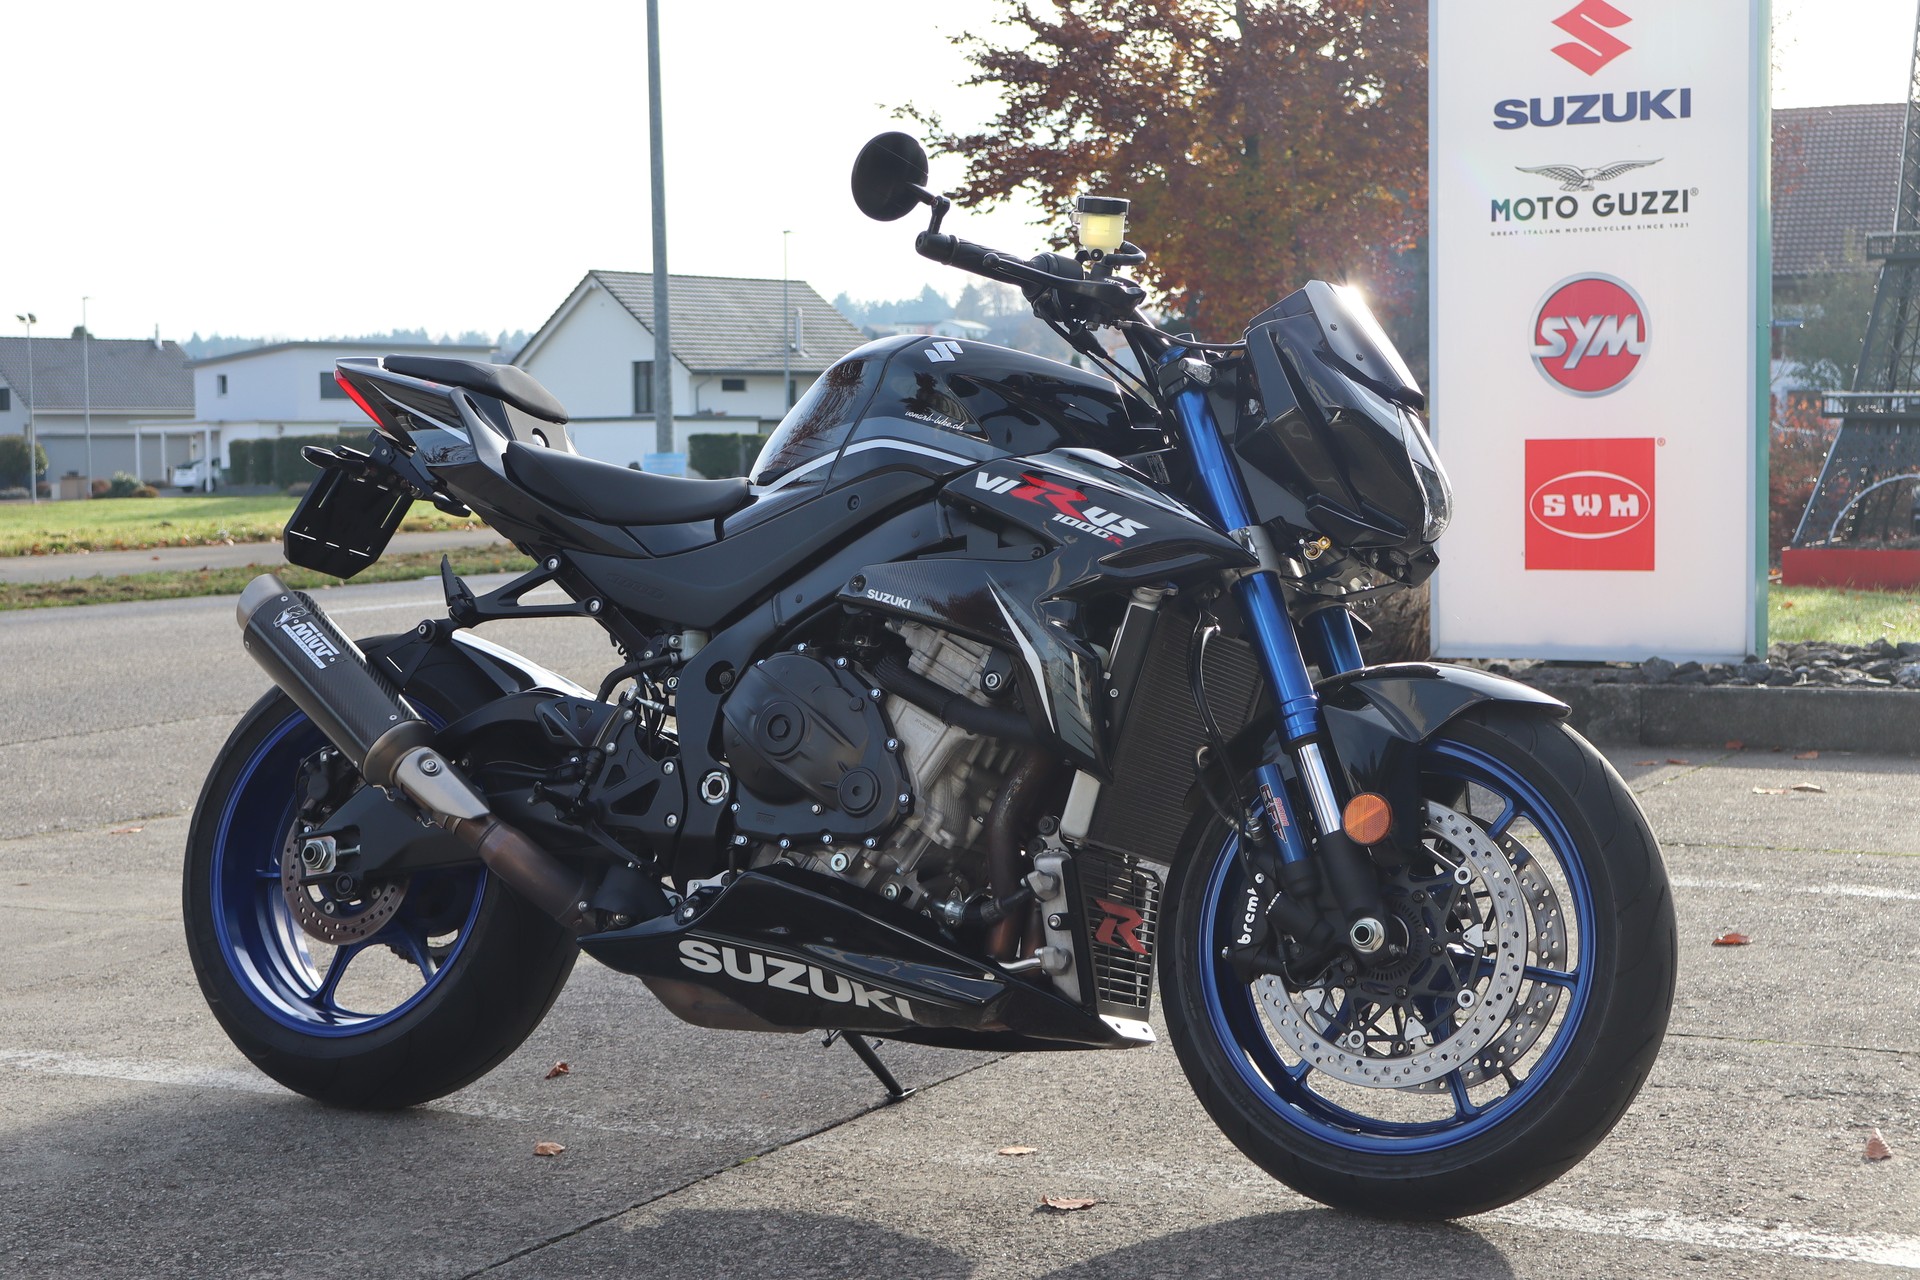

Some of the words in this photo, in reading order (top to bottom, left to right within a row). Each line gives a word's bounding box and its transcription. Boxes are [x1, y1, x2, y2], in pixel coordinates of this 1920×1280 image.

[1493, 87, 1691, 130] SUZUKI
[1491, 195, 1578, 222] MOTO
[1592, 189, 1689, 217] GUZZI
[1565, 224, 1632, 234] MOTORCYCLES
[1637, 223, 1665, 231] SINCE
[1669, 221, 1690, 229] 1921
[1534, 314, 1645, 370] SYM
[1542, 493, 1640, 518] SWM
[866, 588, 912, 610] SUZUKI
[678, 939, 916, 1022] SUZUKI
